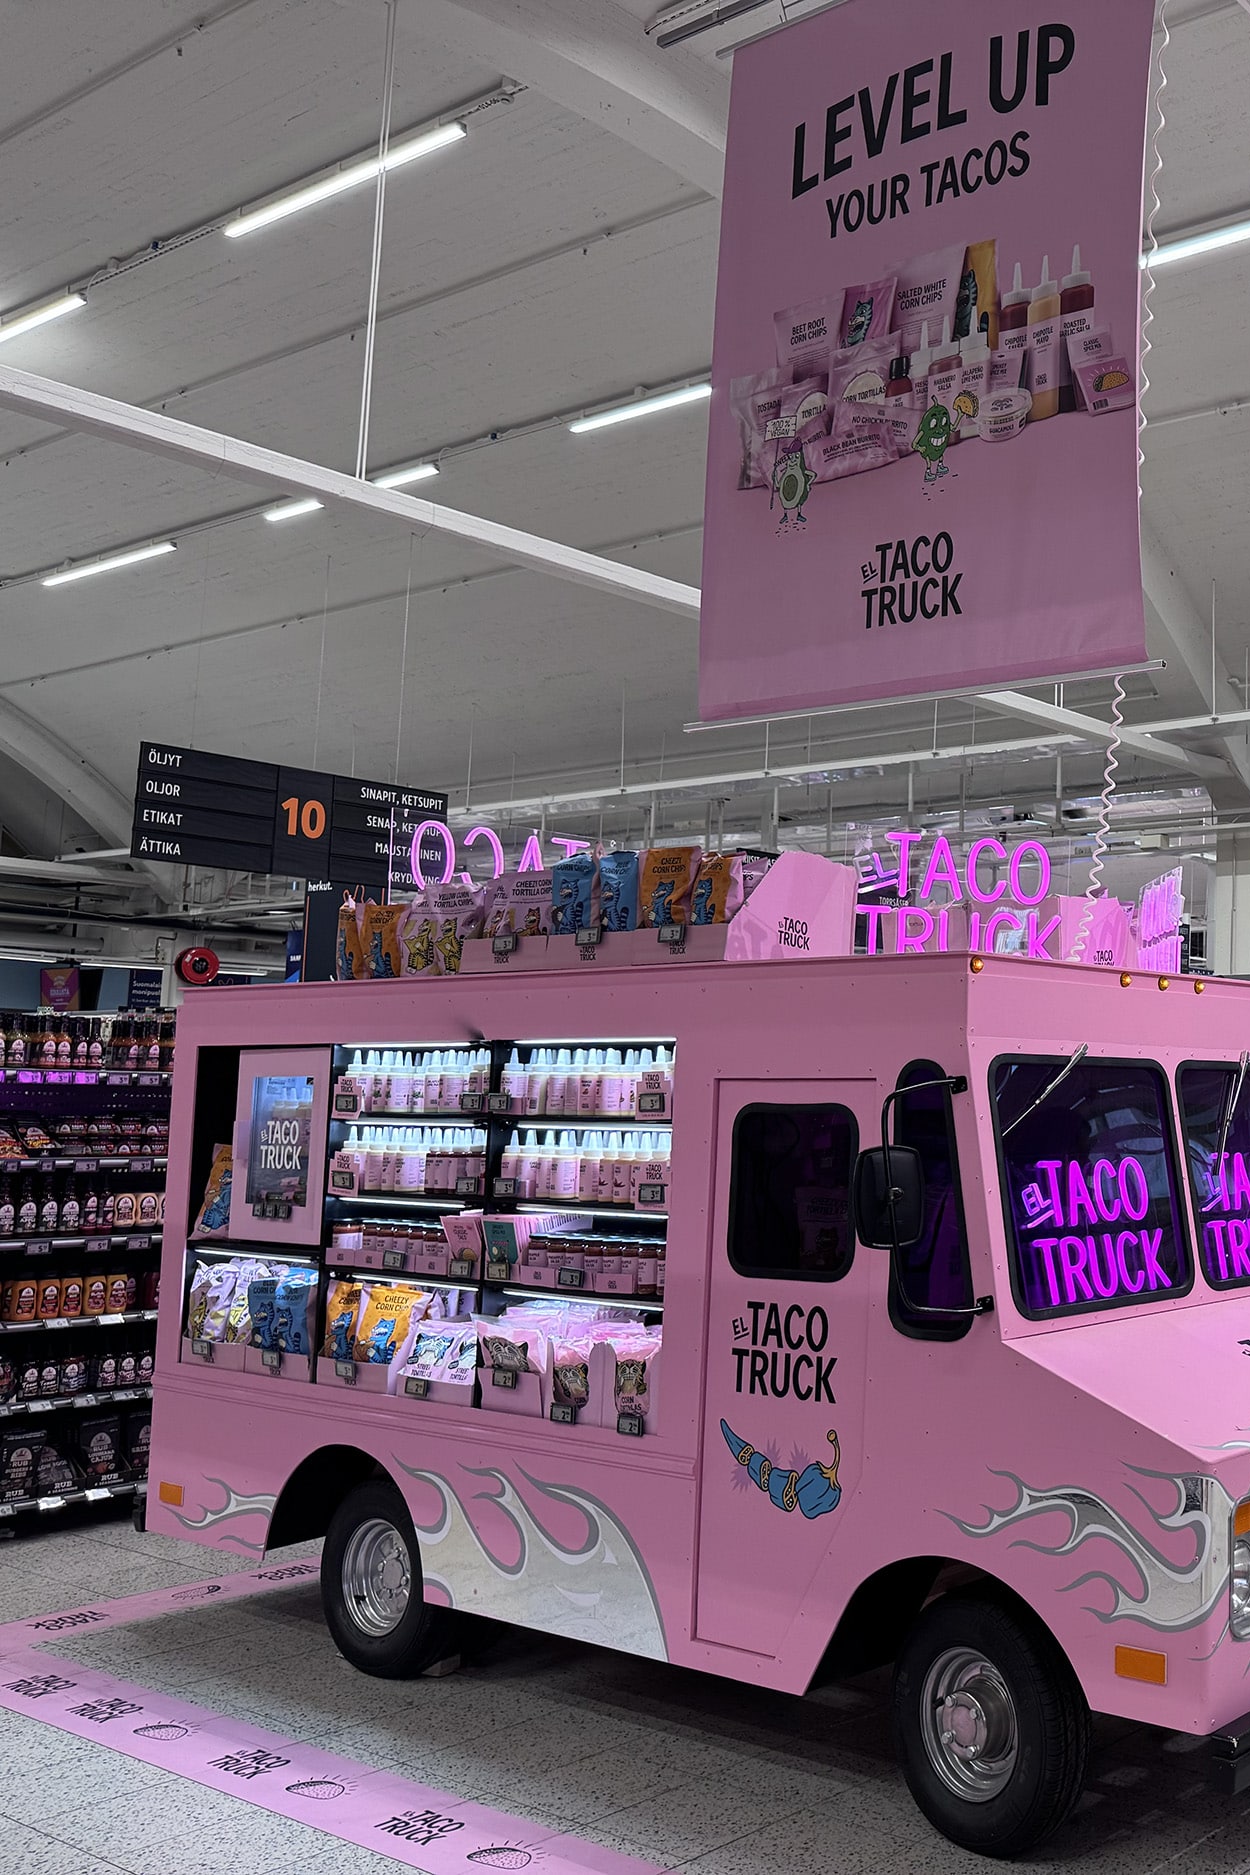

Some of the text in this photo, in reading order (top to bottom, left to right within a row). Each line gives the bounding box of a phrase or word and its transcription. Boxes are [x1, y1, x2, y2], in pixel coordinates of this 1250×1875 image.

[791, 22, 1076, 200] LEVEL UP
[824, 130, 1031, 238] YOUR TACOS
[897, 278, 947, 301] SALTED WHITE
[900, 290, 943, 311] CORN CHIPS
[792, 317, 825, 336] BEET ROOT
[1063, 318, 1087, 329] ROASTED
[790, 326, 827, 346] CORN CHIPS
[858, 385, 887, 401] TORTILLAS
[770, 427, 790, 437] VEGAN
[842, 439, 857, 450] BEAN
[857, 434, 881, 446] BURRITO
[860, 531, 954, 583] EL TACO
[861, 573, 964, 629] TRUCK
[148, 748, 182, 768] ÖLJYT
[145, 780, 180, 797] OLJOR
[360, 787, 443, 811] SINAPIT, KETSUPIT
[143, 809, 183, 827] ETIKAT
[281, 797, 326, 840] 10
[402, 822, 441, 838] KETHUP
[140, 836, 181, 856] ÄTTIKA
[375, 842, 441, 862] MAUSTAINEN
[652, 866, 670, 874] CORN
[853, 831, 1051, 905] EL TACO
[512, 888, 540, 896] TORTILLA
[783, 917, 808, 936] TACO
[855, 904, 1062, 960] TRUCK
[778, 930, 810, 951] TRUCK
[1096, 950, 1113, 962] TACO
[267, 1121, 299, 1145] TACO
[260, 1145, 302, 1170] TRUCK
[1021, 1156, 1149, 1229] EL TACO
[1032, 1228, 1172, 1306] TRUCK
[375, 1303, 395, 1311] CORN
[385, 1295, 409, 1304] CHEEZY
[731, 1301, 829, 1352] EL TACO
[731, 1348, 838, 1404] TRUCK
[54, 1480, 72, 1490] RUB
[101, 1473, 118, 1482] RUB
[5, 1489, 24, 1498] RUB
[1, 1679, 58, 1700] TRUCK
[65, 1702, 124, 1724] TRUCK
[104, 1698, 144, 1715] TACO
[207, 1755, 272, 1780] TRUCK
[248, 1749, 291, 1769] TACO
[415, 1809, 465, 1833] TACO
[374, 1816, 447, 1847] TRUCK
